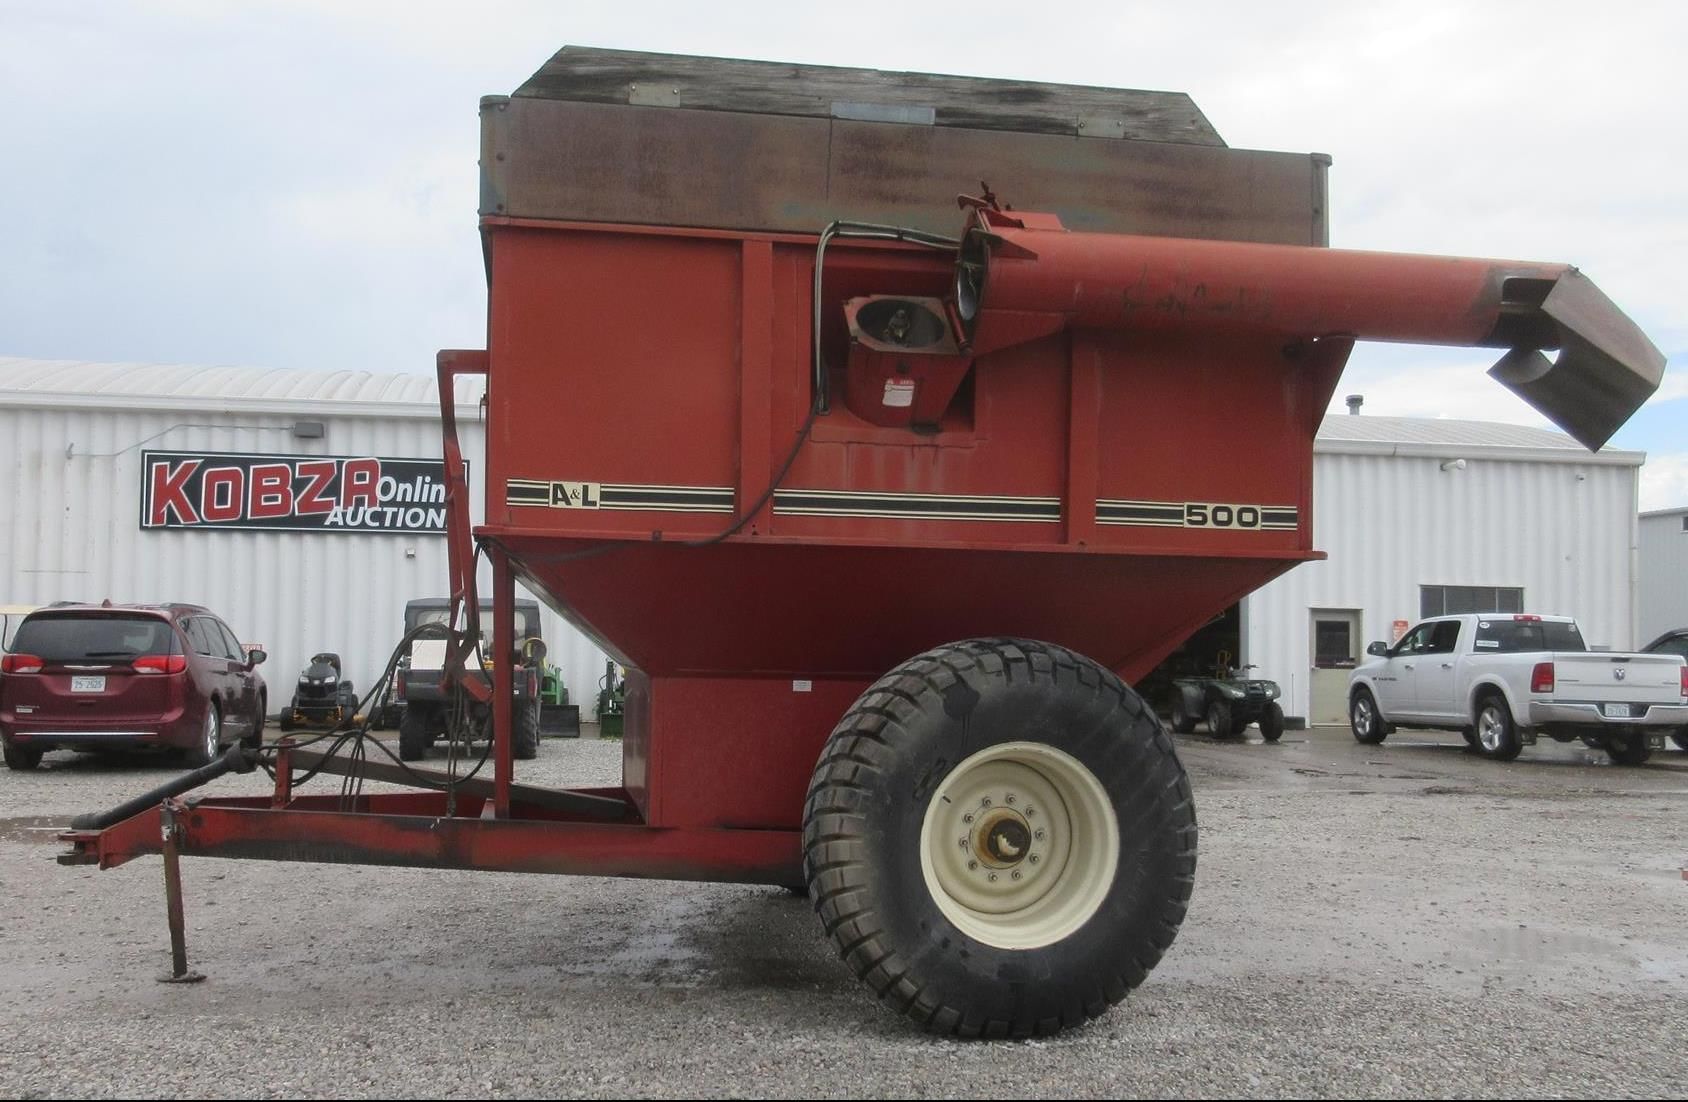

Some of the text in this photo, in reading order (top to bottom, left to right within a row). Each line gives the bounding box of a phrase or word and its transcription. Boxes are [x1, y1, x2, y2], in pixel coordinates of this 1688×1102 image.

[151, 458, 446, 526] KOBZA Onlin
[551, 483, 597, 507] A&L
[324, 507, 449, 529] AUCTION
[1186, 504, 1259, 528] 500
